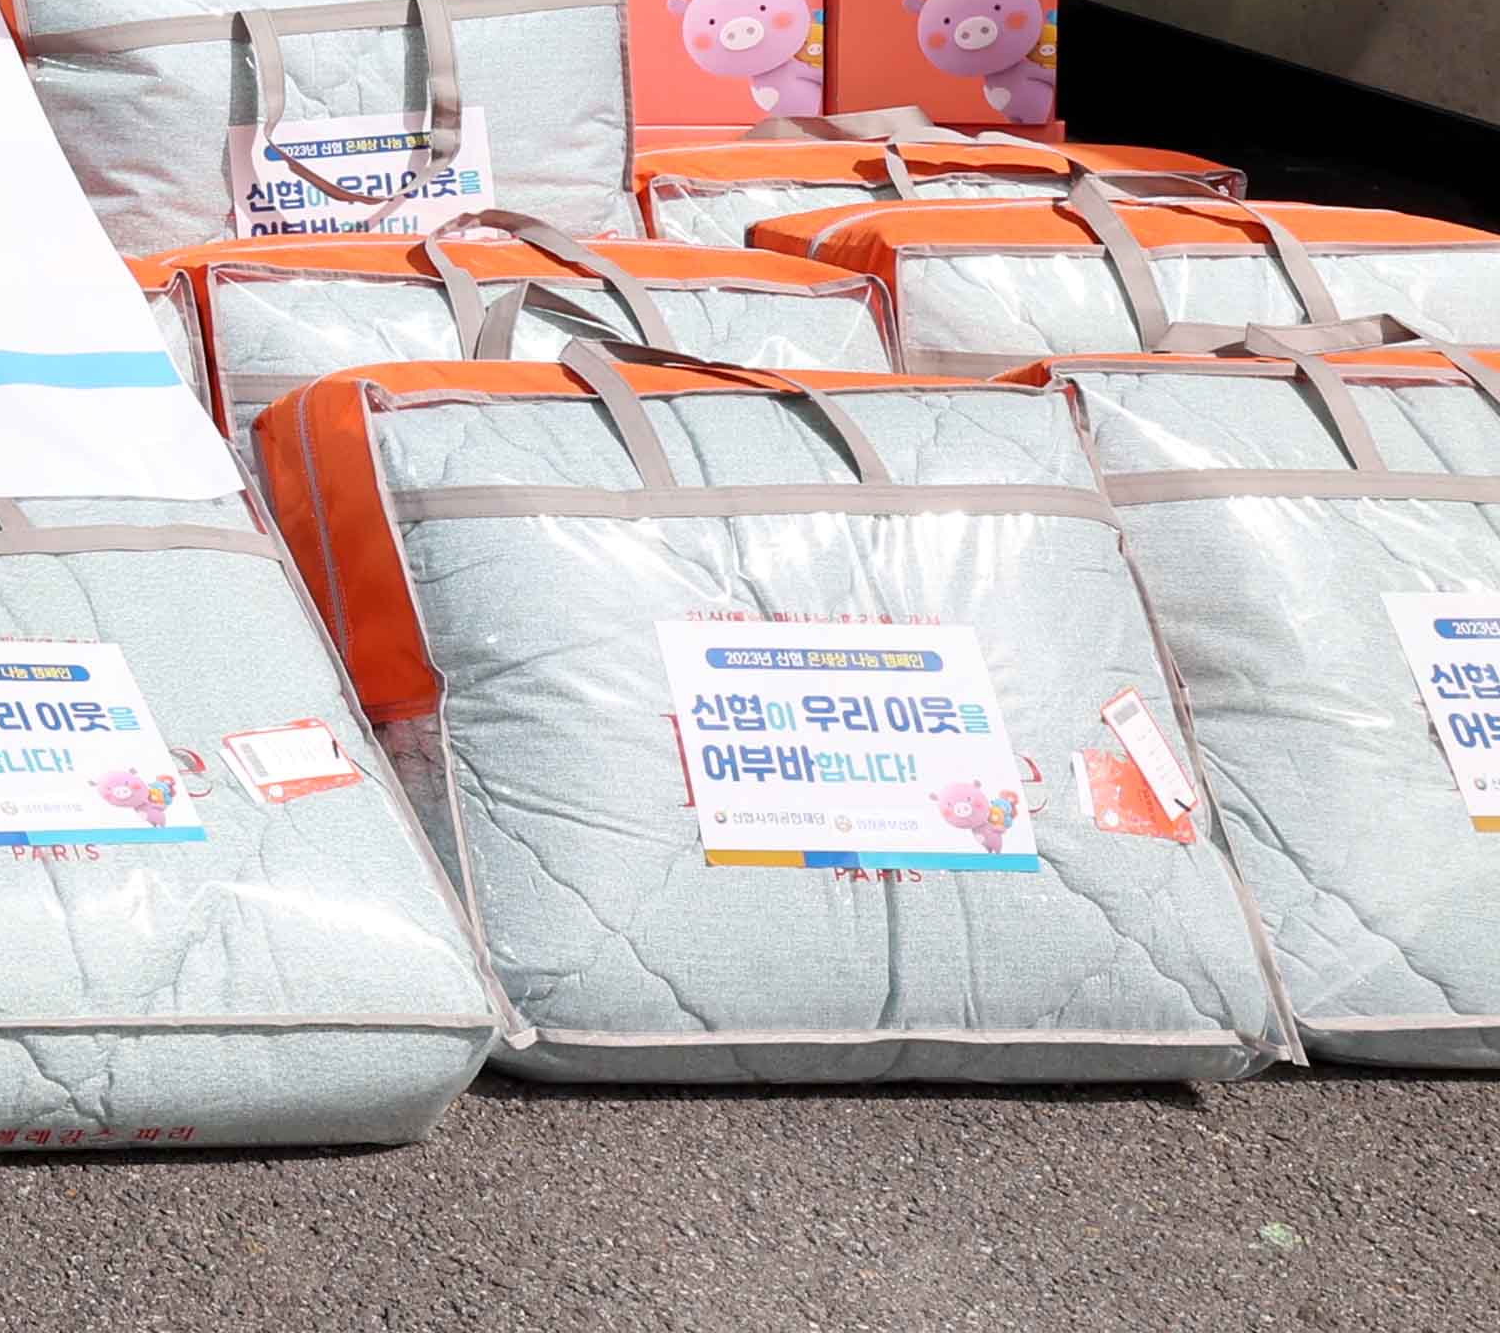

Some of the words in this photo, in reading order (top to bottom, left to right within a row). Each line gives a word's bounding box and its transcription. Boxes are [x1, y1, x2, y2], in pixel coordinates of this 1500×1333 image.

[35, 702, 140, 732] 이웃을
[691, 693, 796, 731] 신협이
[803, 696, 879, 733] 우리
[886, 697, 990, 733] 이웃을
[702, 744, 916, 783] 어부바합니다!
